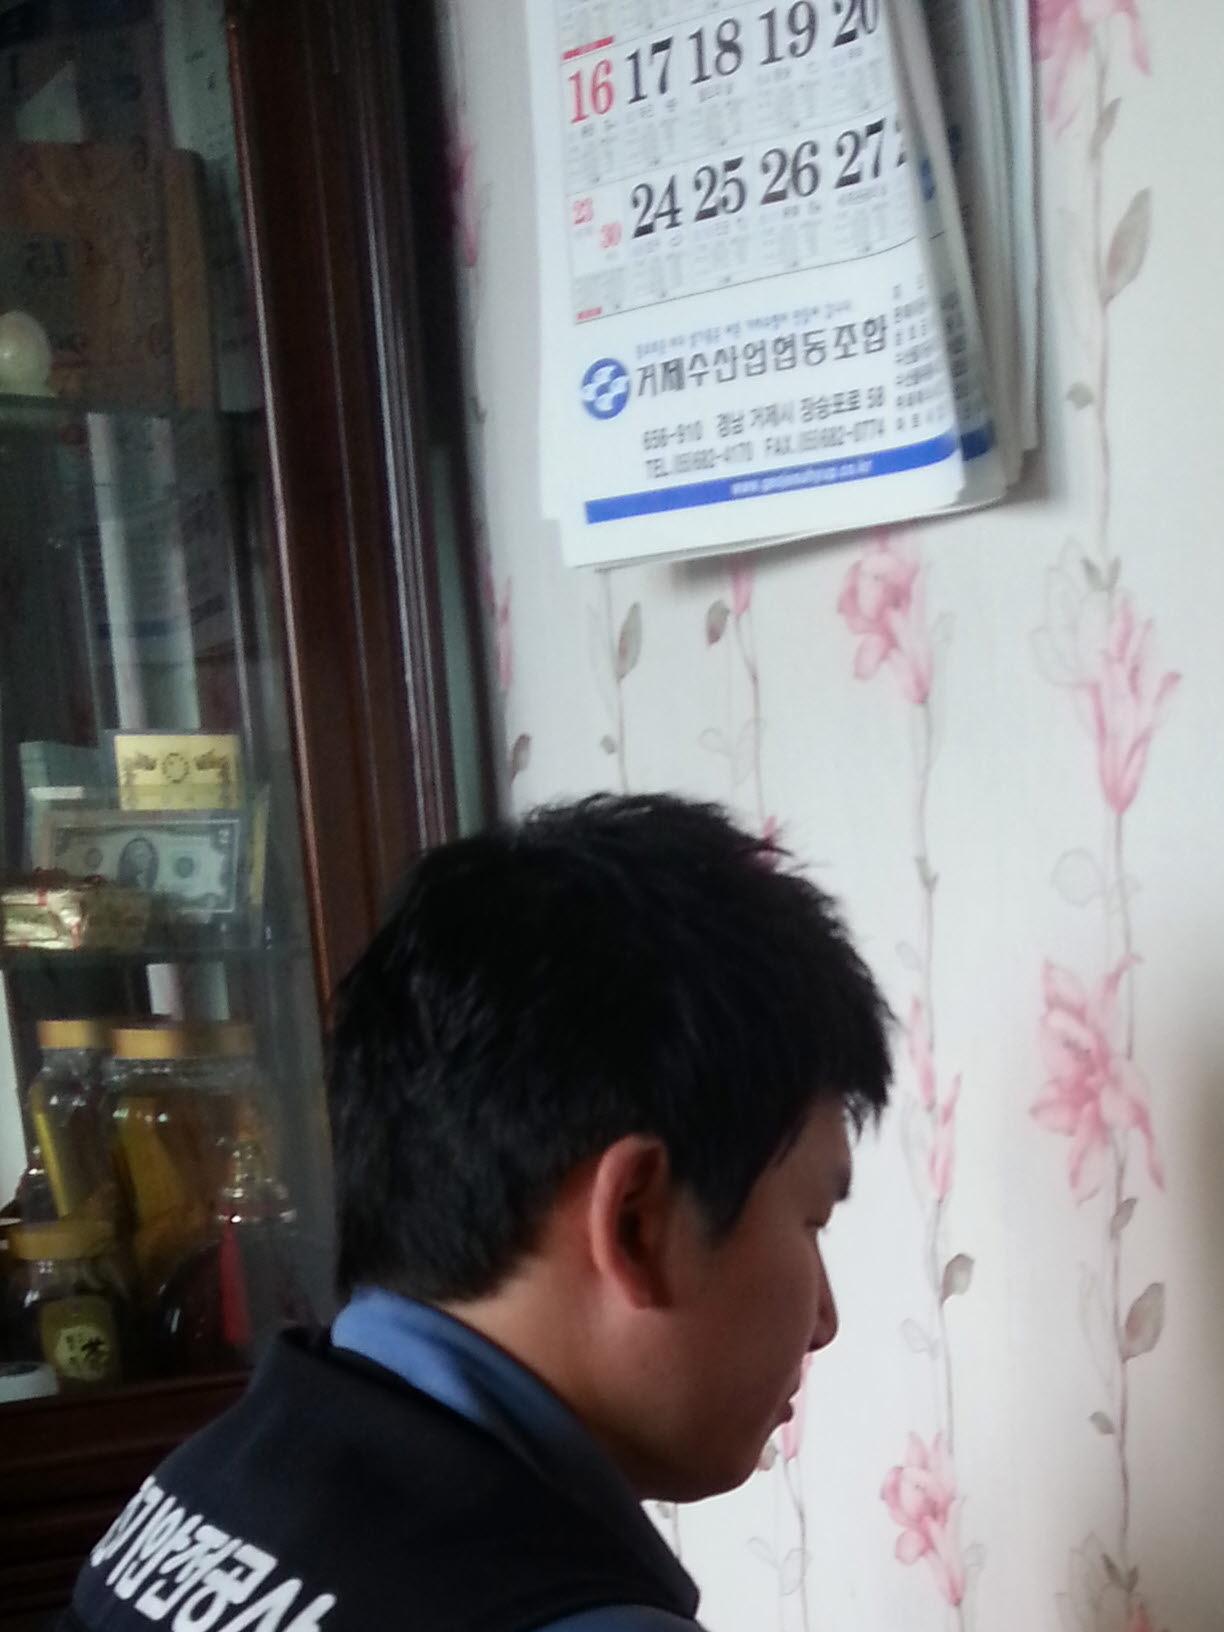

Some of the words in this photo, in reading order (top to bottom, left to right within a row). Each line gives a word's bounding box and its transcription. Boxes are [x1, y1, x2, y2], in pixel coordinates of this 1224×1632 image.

[568, 59, 615, 123] 16
[626, 36, 673, 104] 17
[689, 17, 742, 85] 18
[758, 1, 817, 65] 19
[833, 0, 879, 47] 20
[630, 174, 682, 239] 24
[693, 156, 746, 222] 25
[760, 140, 819, 205] 26
[834, 117, 886, 189] 27
[636, 314, 888, 396] 거제수산업협동조합
